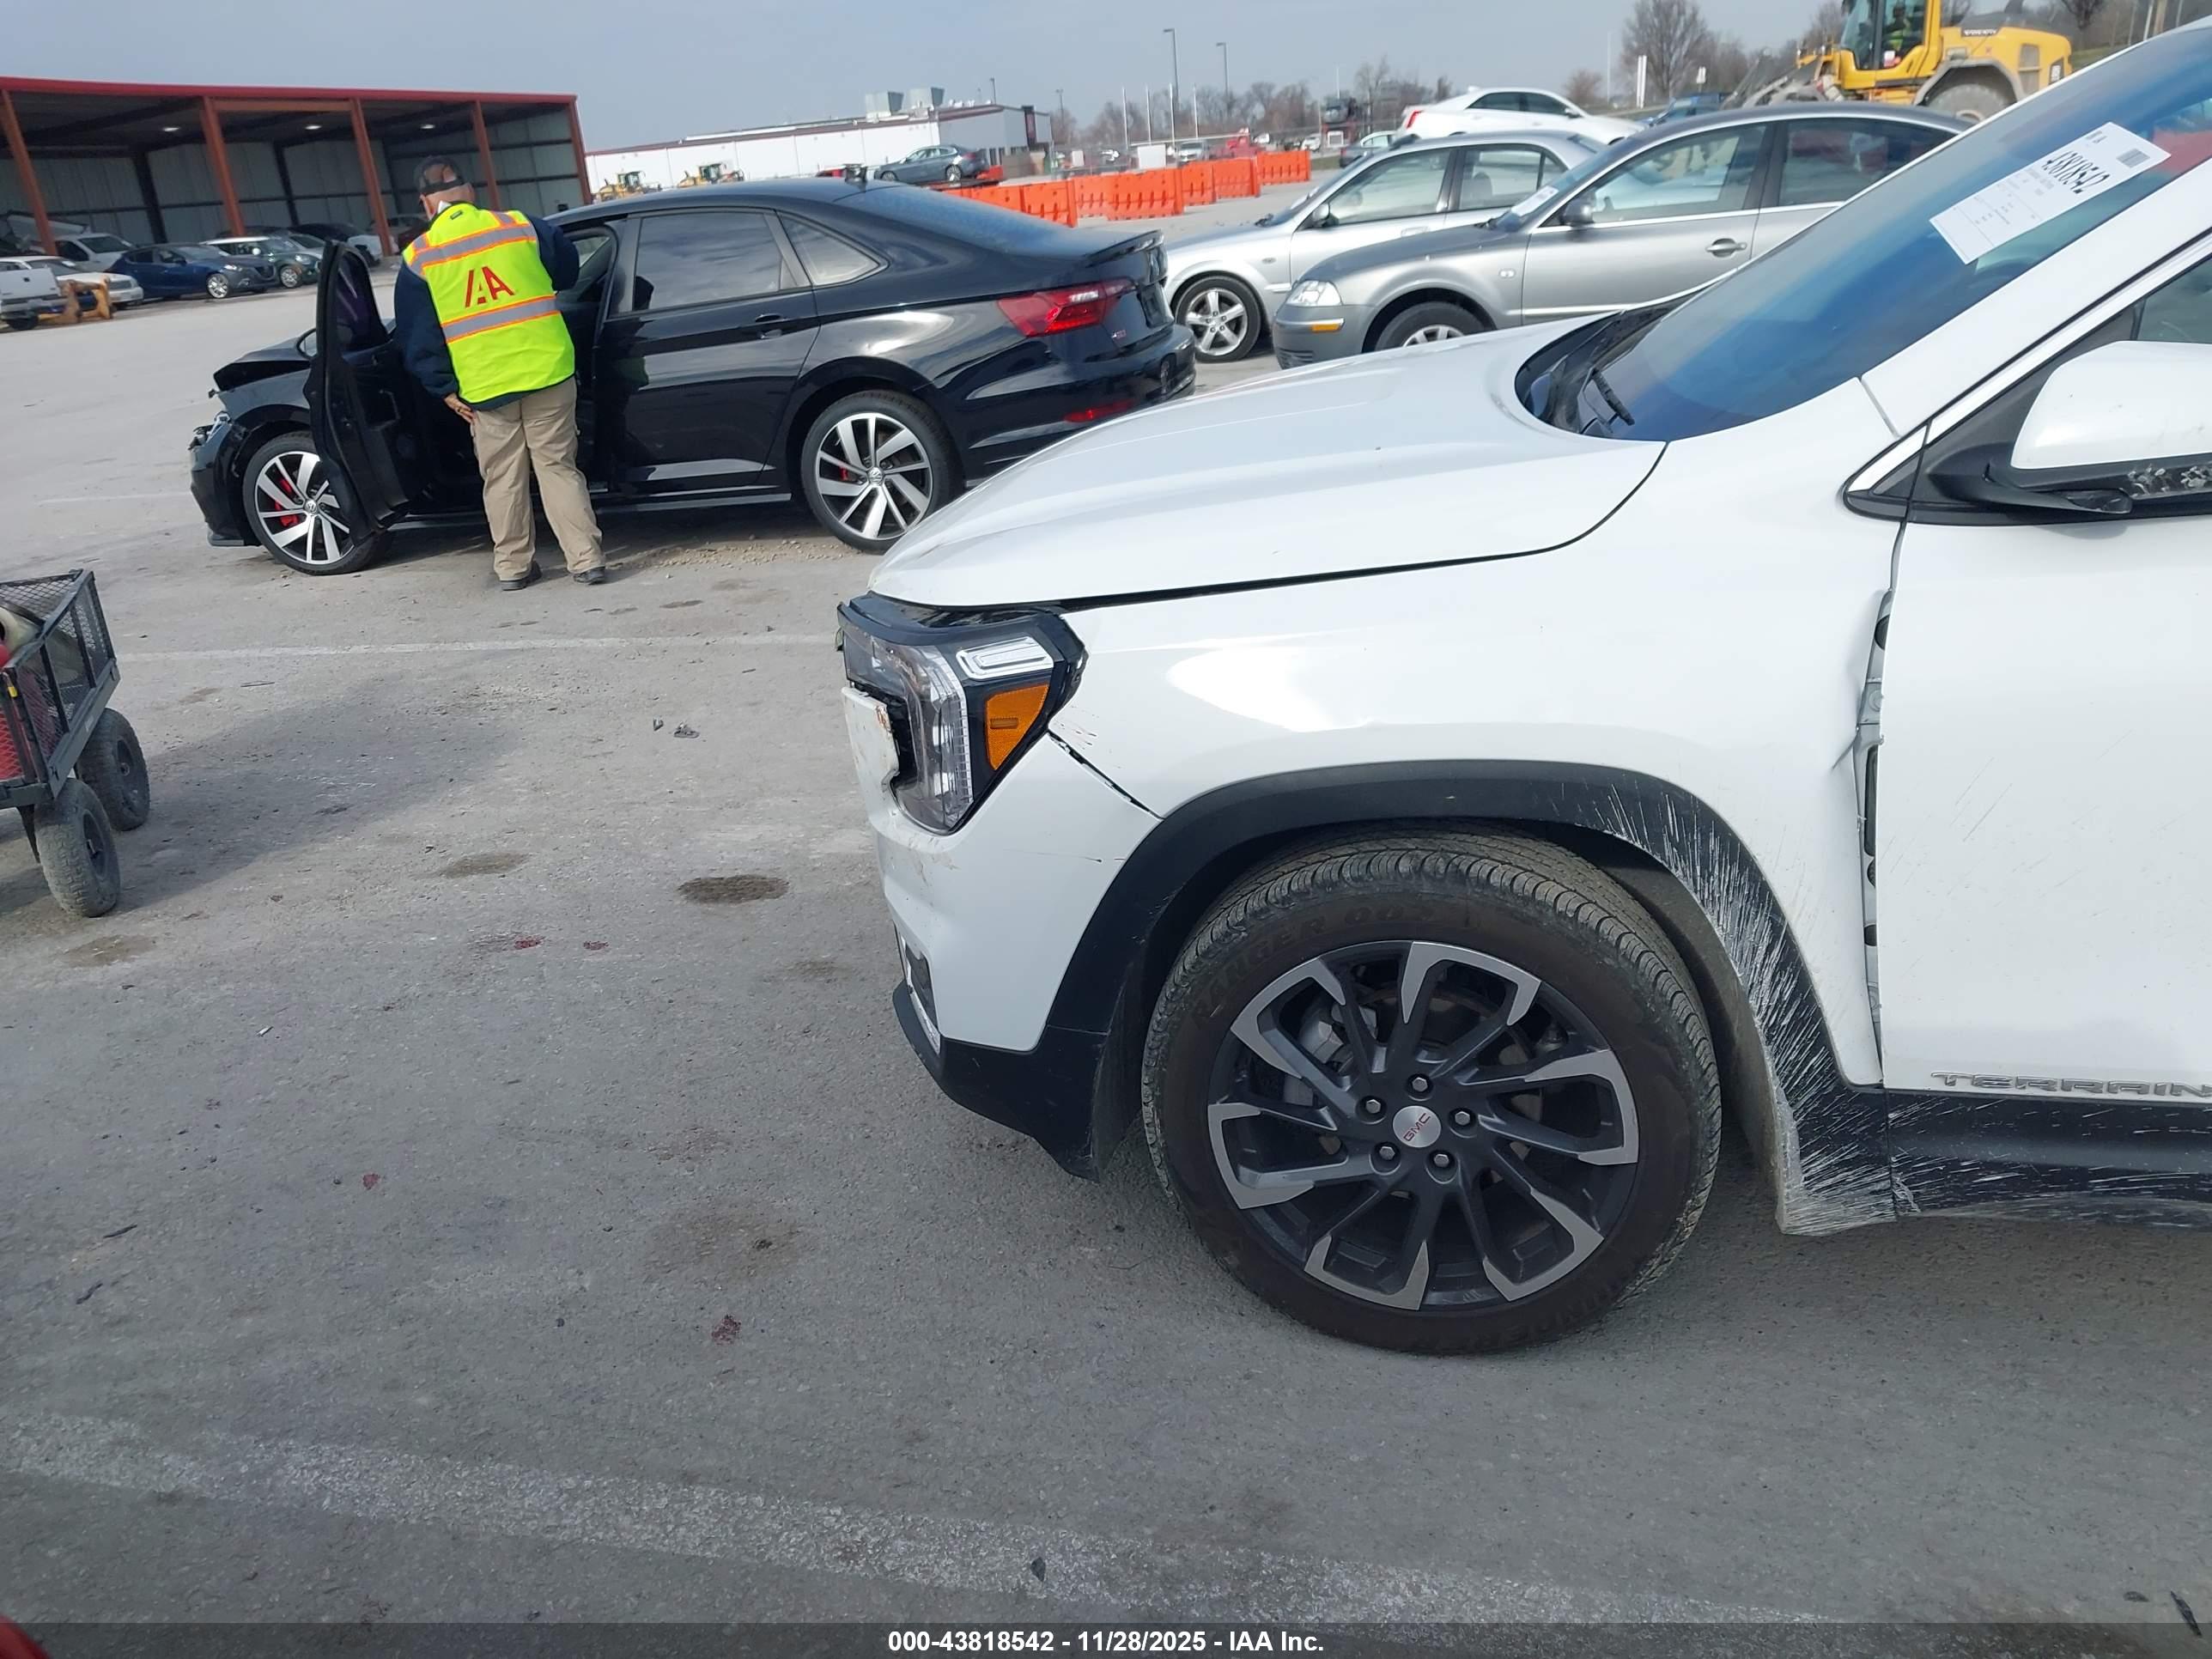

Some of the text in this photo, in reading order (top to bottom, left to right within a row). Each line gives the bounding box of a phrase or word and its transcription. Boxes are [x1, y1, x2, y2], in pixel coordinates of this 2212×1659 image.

[2041, 150, 2111, 194] 43818542
[1931, 1073, 2212, 1097] TERRAIN
[1403, 1113, 1431, 1142] GMC
